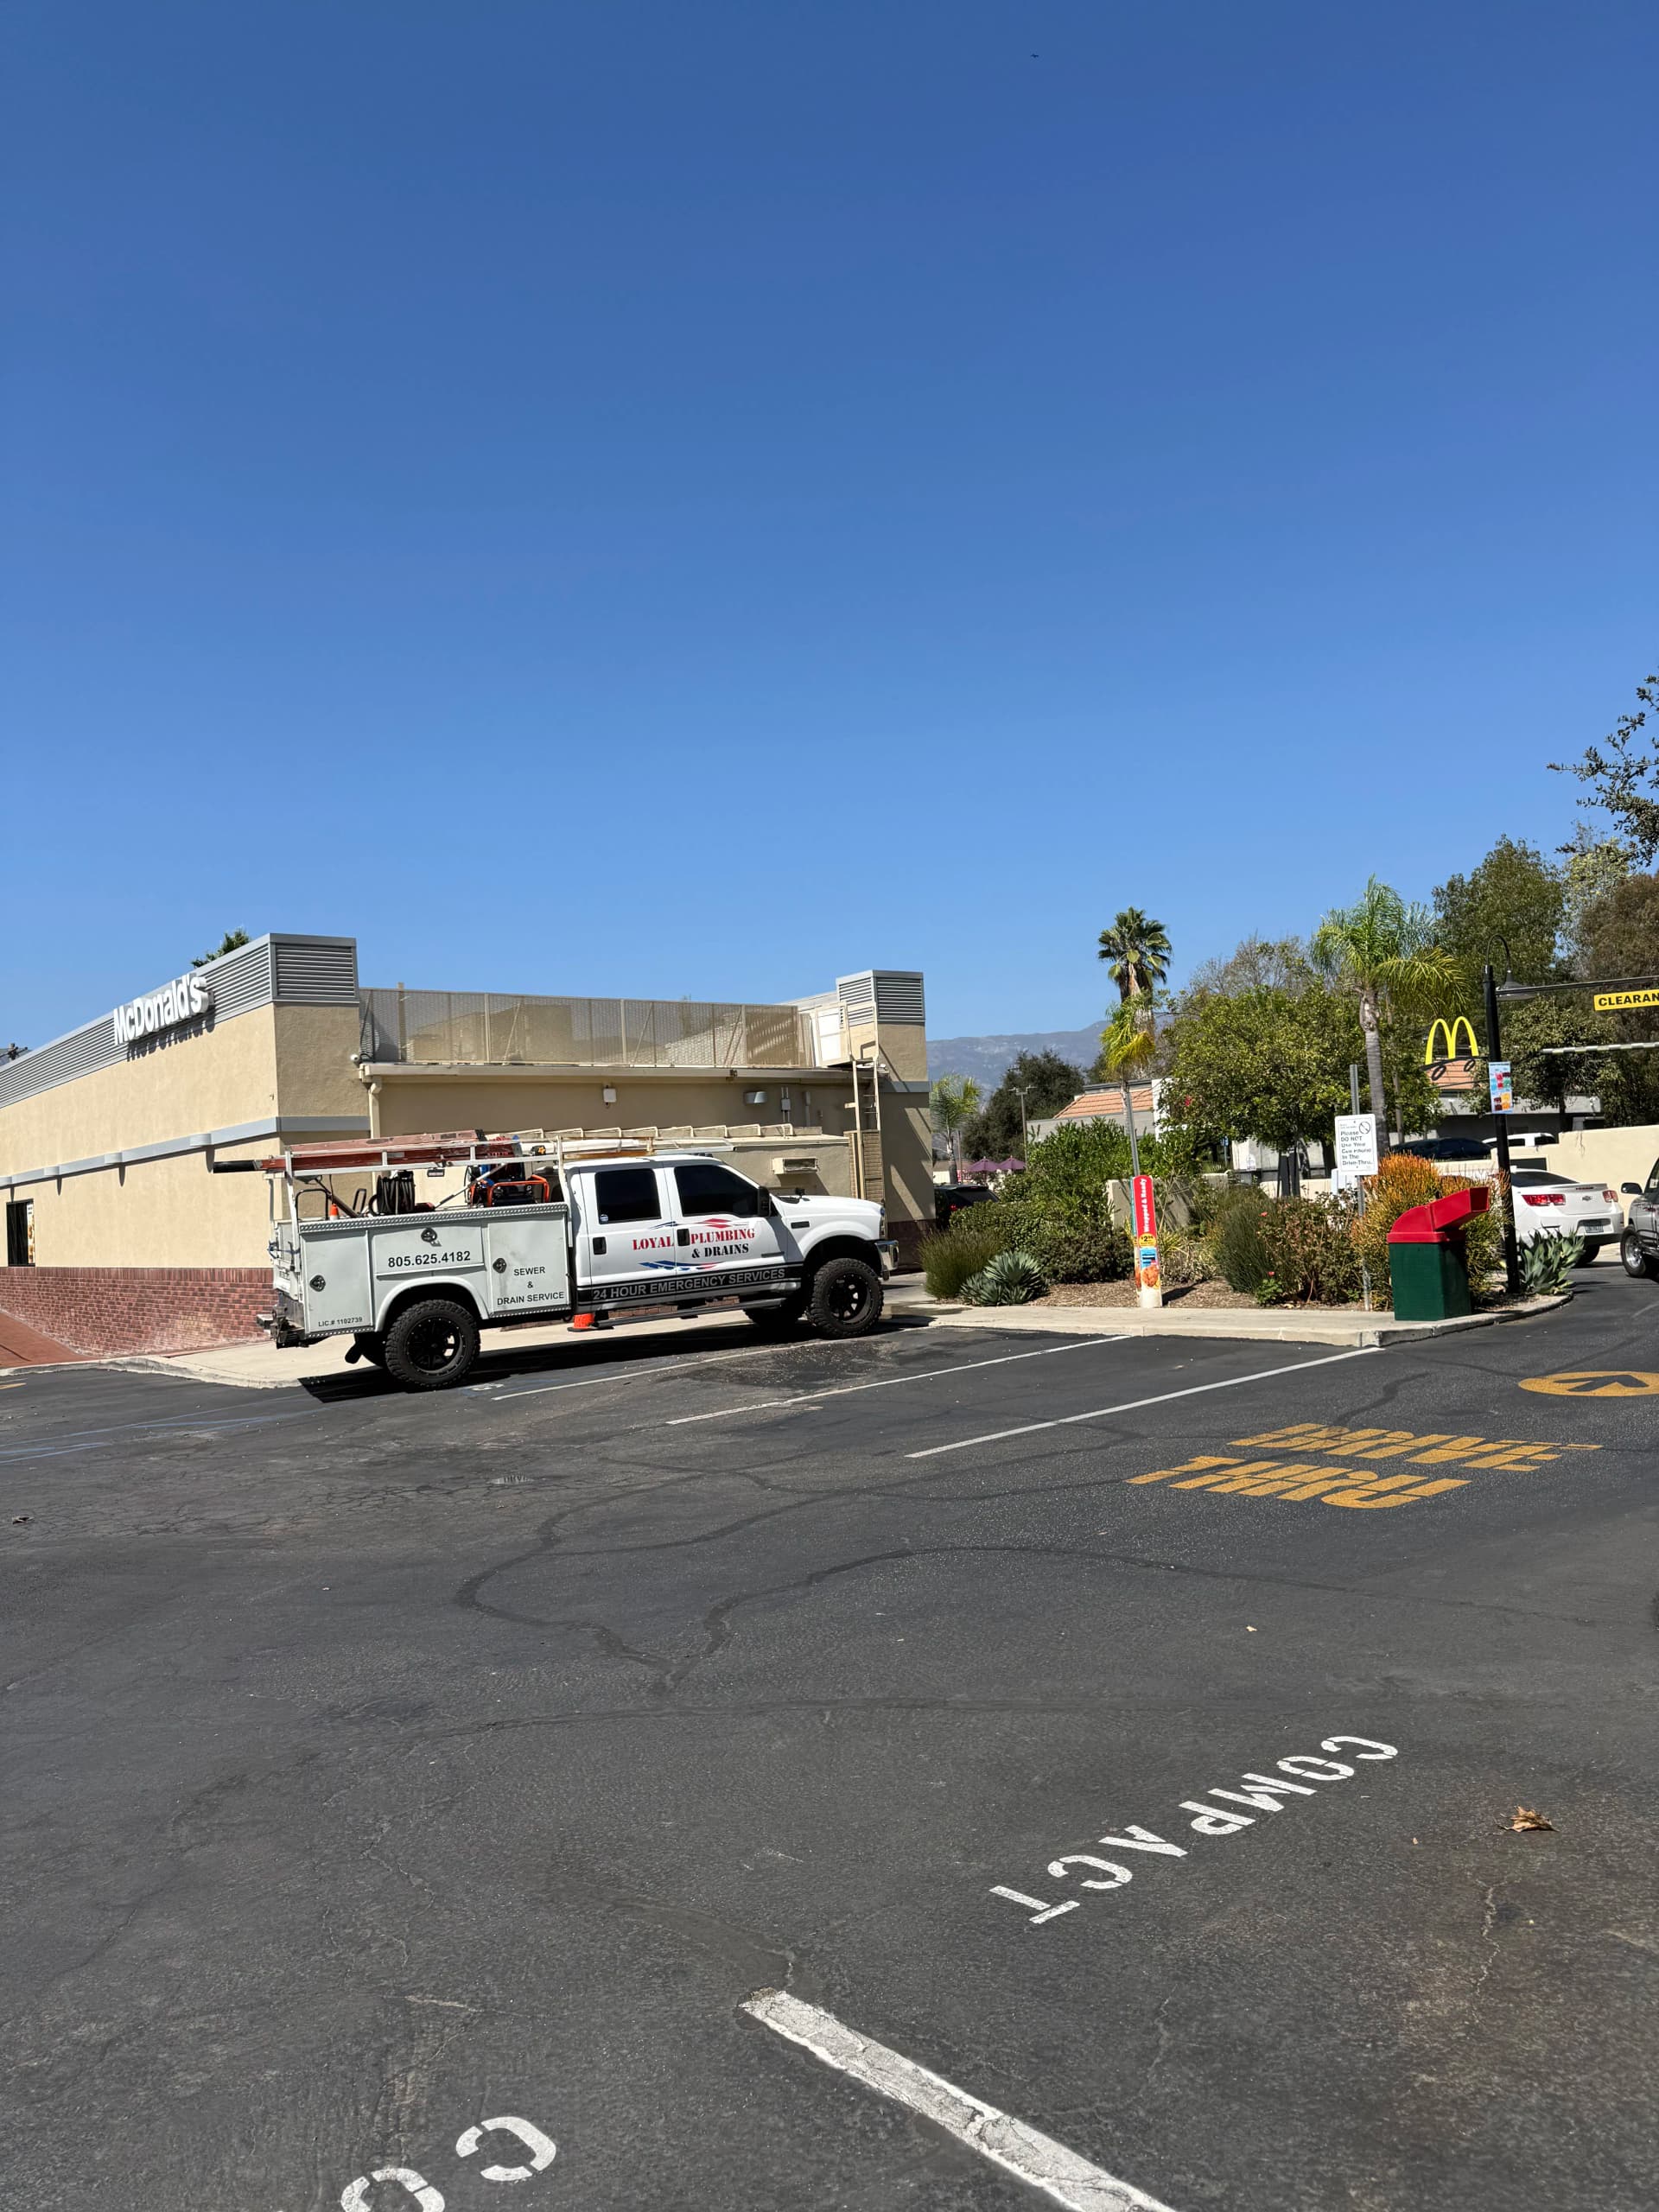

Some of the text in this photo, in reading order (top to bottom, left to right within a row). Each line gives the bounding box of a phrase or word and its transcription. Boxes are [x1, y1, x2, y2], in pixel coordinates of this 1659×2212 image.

[113, 973, 205, 1046] McDonald's
[632, 1228, 755, 1251] LOYAL PLUMBING
[388, 1250, 471, 1268] 805.625.4182
[691, 1243, 749, 1259] & DRAINS
[513, 1266, 546, 1276] SEWER
[593, 1268, 785, 1300] 24 HOUR EMERGENCY SERVICES
[497, 1291, 564, 1306] DRAIN SERVICE
[336, 1316, 363, 1325] 1102739
[1227, 1422, 1604, 1471] DRIVE
[1126, 1456, 1472, 1510] THRU
